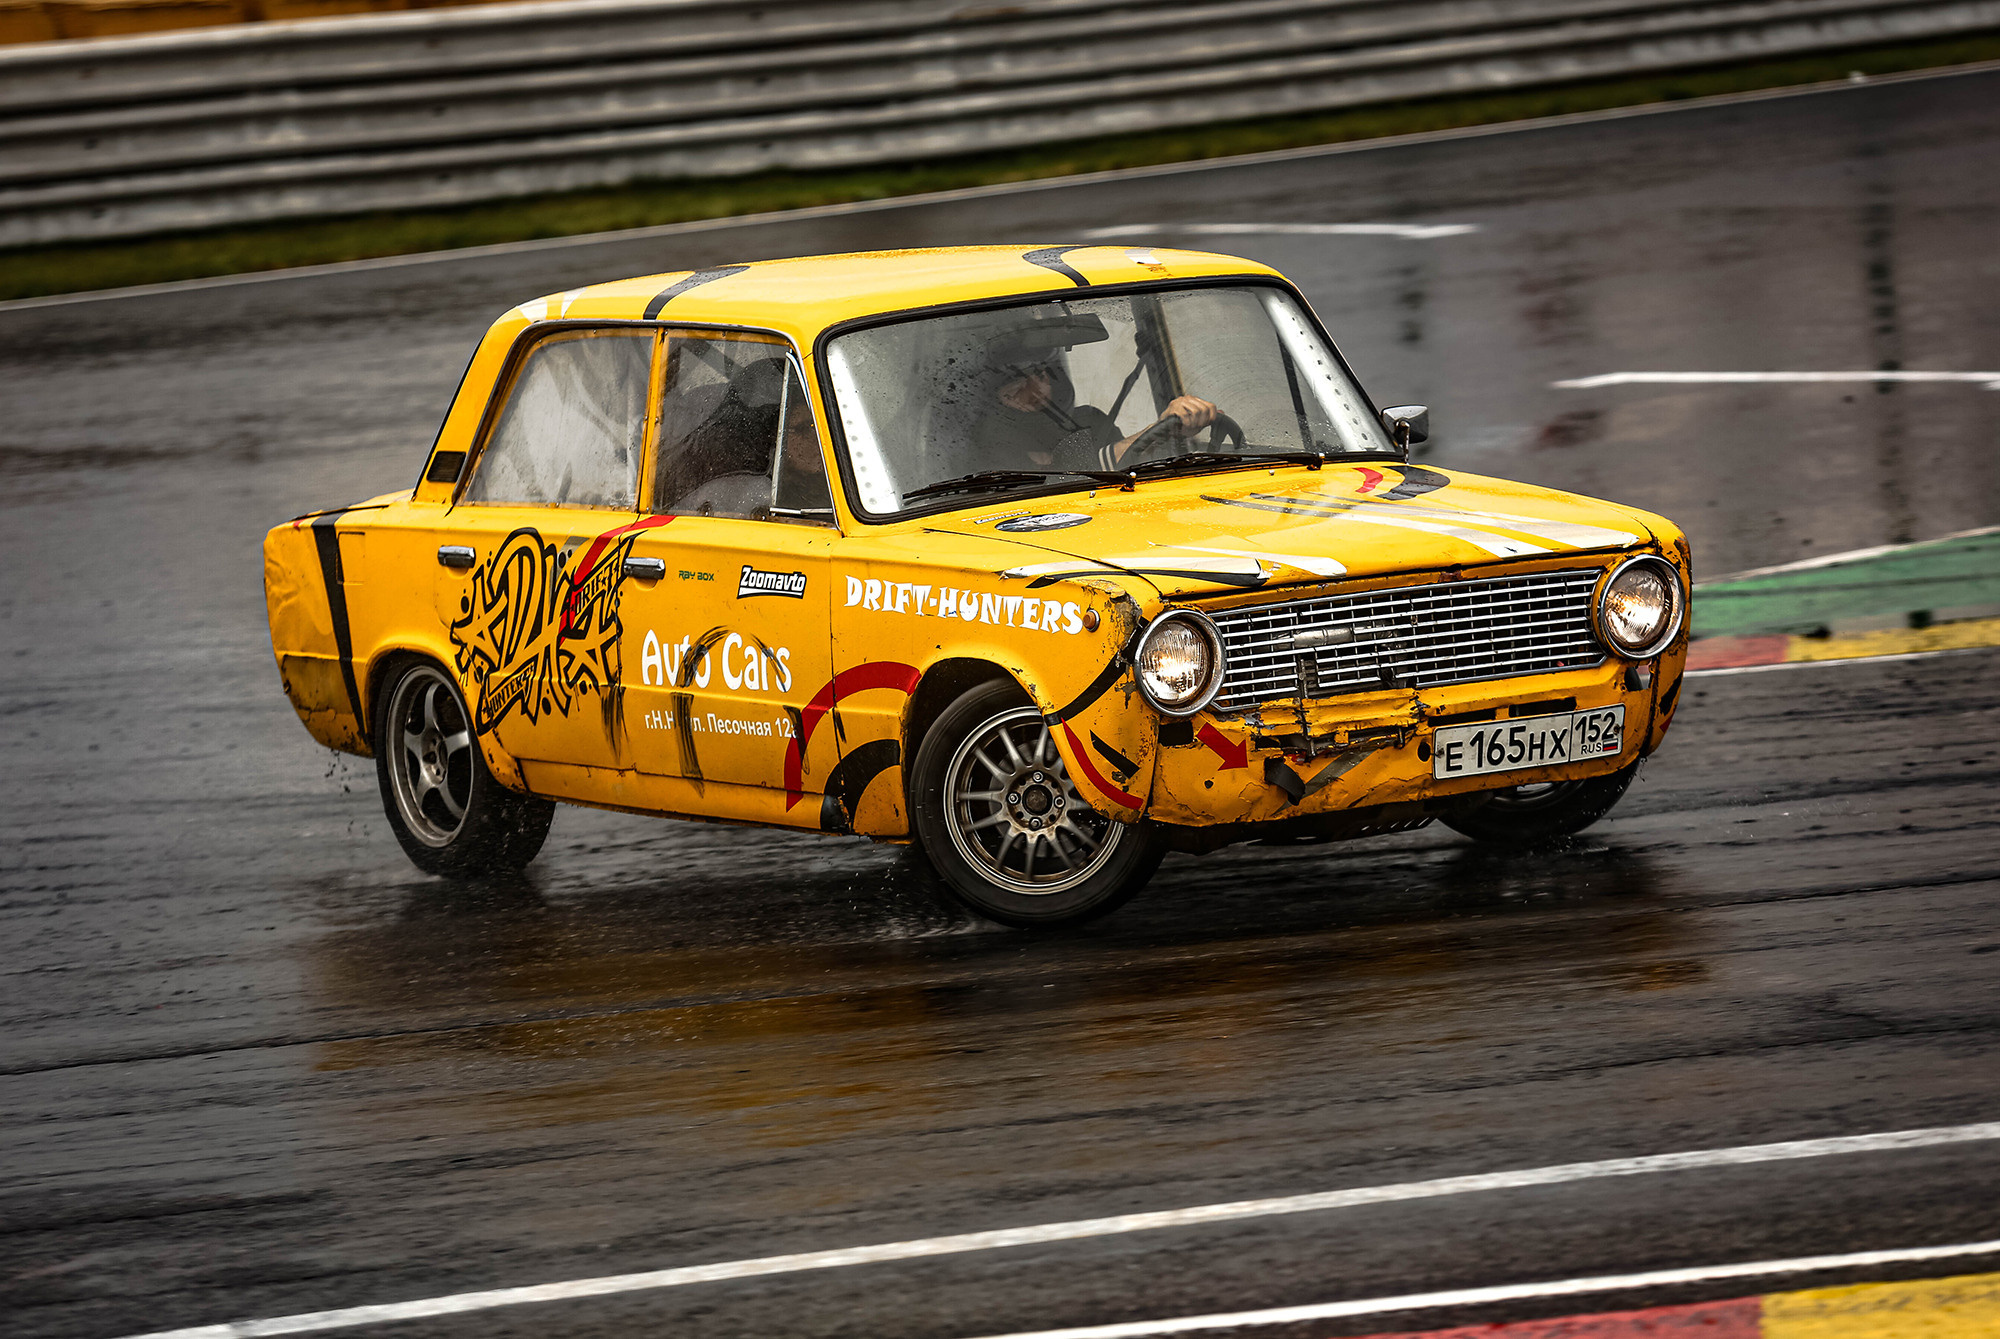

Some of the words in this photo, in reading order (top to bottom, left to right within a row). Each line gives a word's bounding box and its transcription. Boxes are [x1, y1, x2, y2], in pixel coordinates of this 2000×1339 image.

[697, 571, 715, 582] BOX
[739, 566, 806, 592] Zoomavto
[843, 574, 1084, 635] DRIFT-HUNTERS
[721, 631, 793, 693] Cars
[706, 713, 772, 737] Песочная
[1574, 711, 1616, 745] 152
[1580, 741, 1603, 755] RUS
